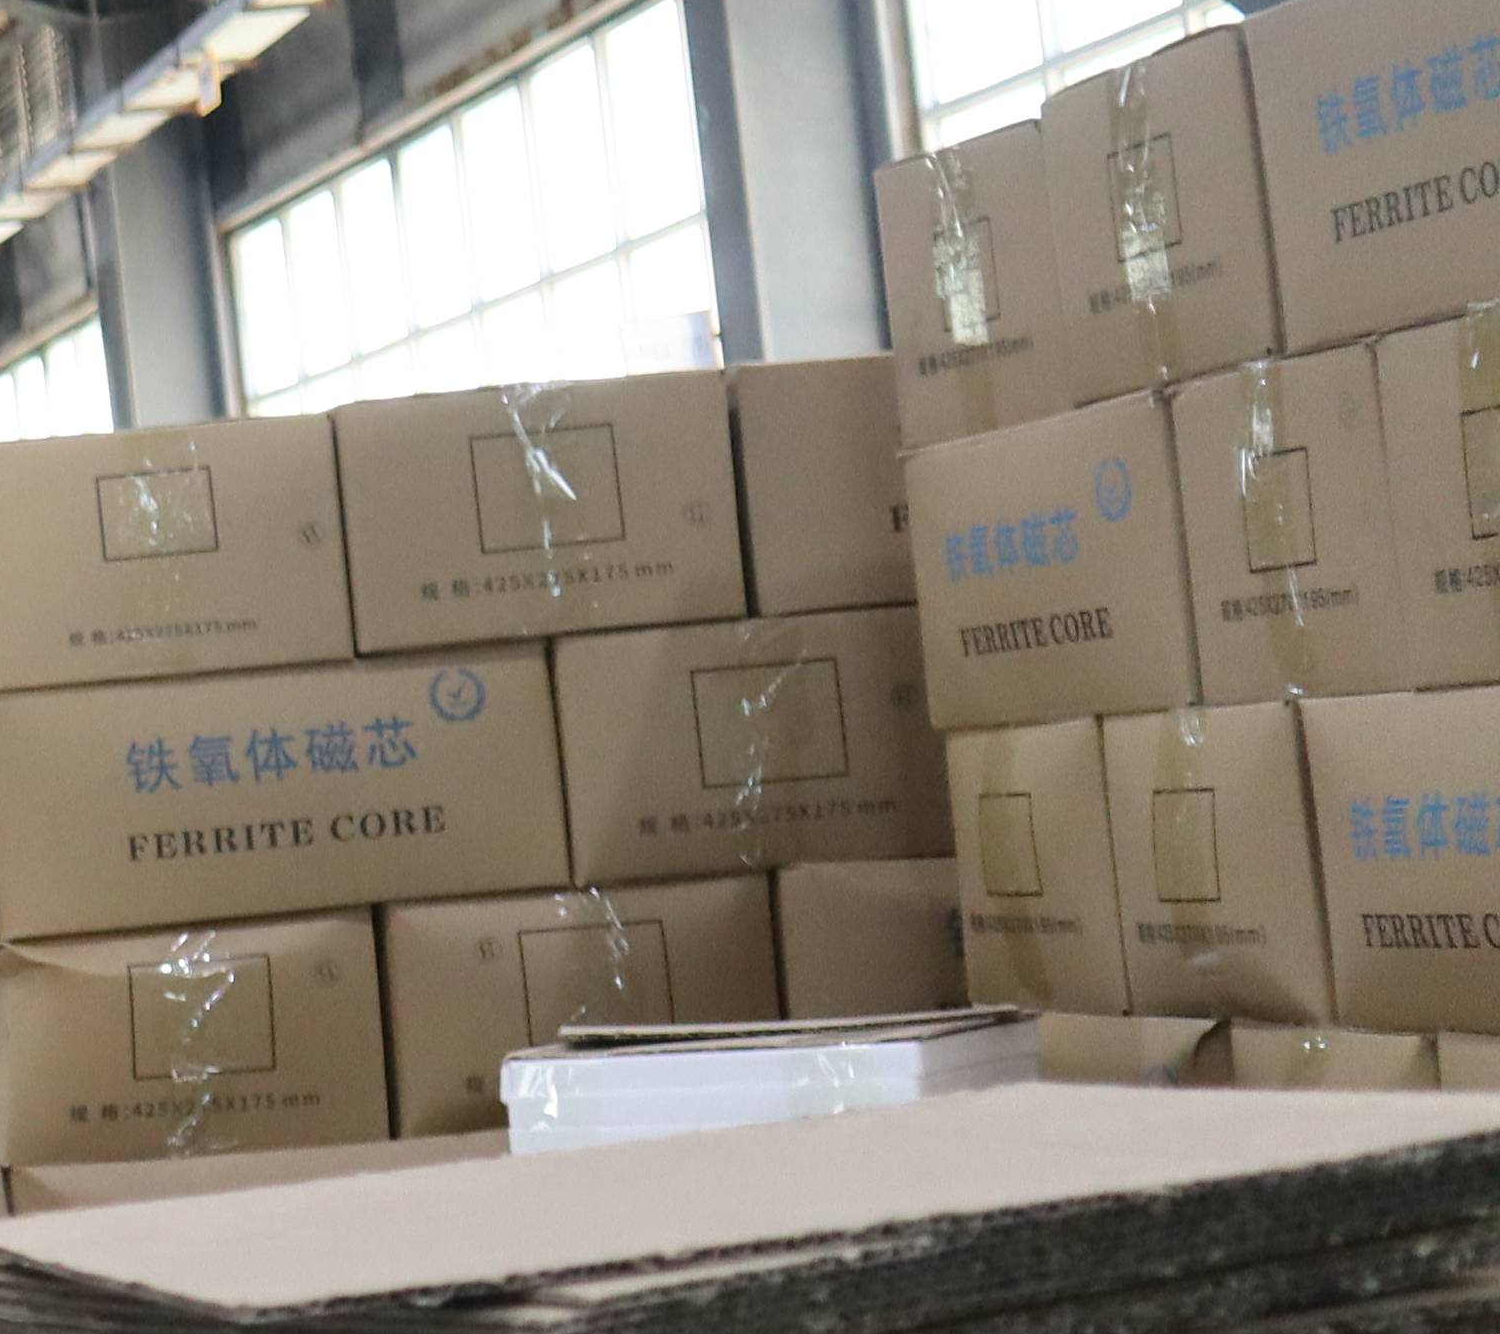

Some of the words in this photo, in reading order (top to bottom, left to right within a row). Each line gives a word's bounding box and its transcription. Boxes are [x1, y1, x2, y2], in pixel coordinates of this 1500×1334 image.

[1330, 174, 1453, 244] FERRITE
[1459, 161, 1500, 205] CO
[959, 617, 1049, 658] FERRITE
[1049, 607, 1114, 645] CORE
[125, 715, 418, 796] 铁氧体磁芯
[126, 815, 315, 864] FERRITE
[329, 804, 447, 844] CORE
[1361, 913, 1481, 950] FERRITE
